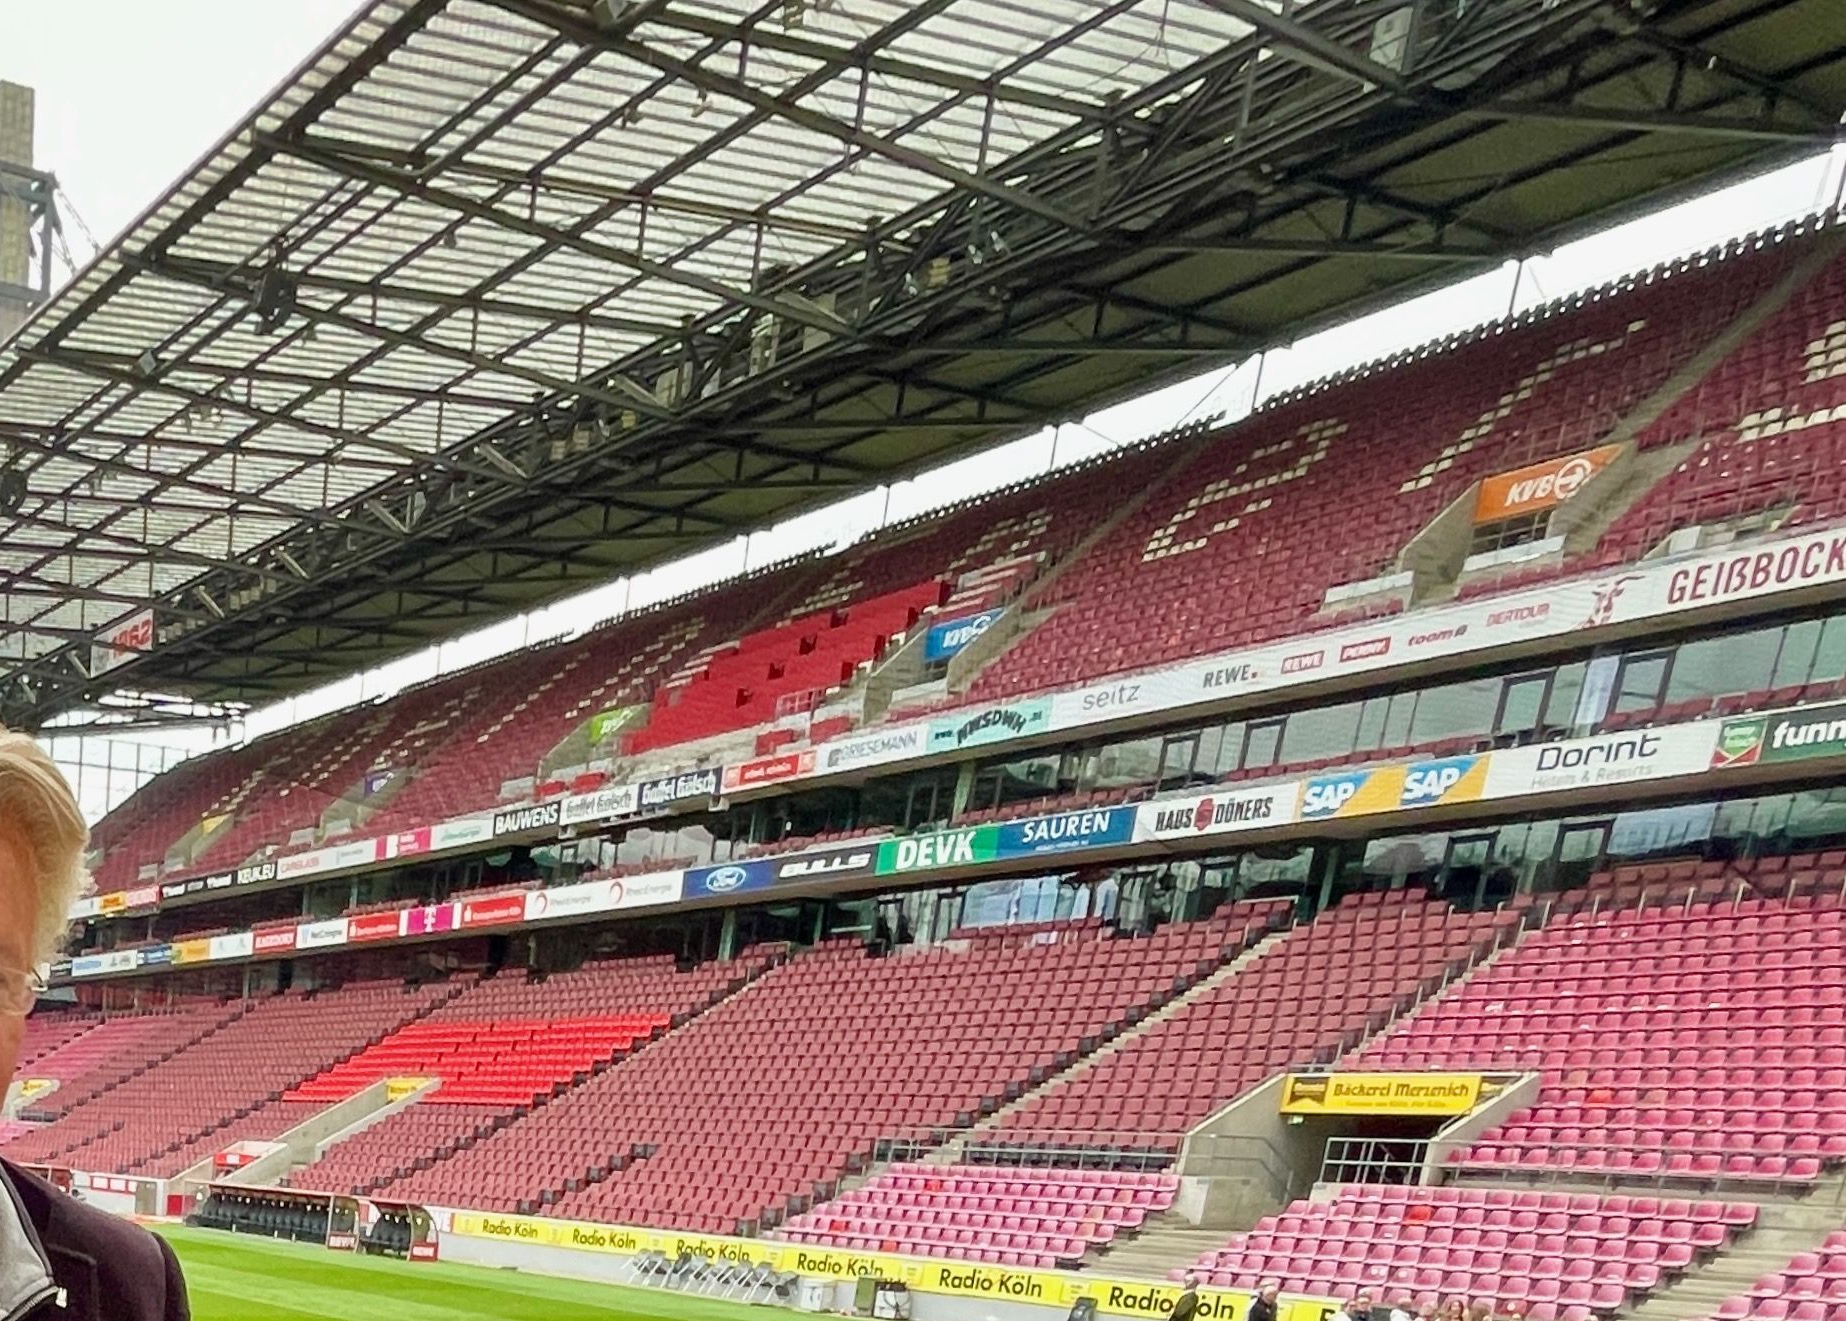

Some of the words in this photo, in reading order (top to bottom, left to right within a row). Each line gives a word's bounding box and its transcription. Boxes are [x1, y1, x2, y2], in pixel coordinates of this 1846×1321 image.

[1408, 630, 1453, 646] toom
[1082, 685, 1140, 710] seitz
[1536, 734, 1661, 770] Dorint
[1304, 782, 1355, 813] SAP
[1405, 768, 1460, 799] SAP
[495, 804, 558, 834] BAUWENS
[1215, 797, 1273, 822] DÖNERS
[1022, 812, 1111, 843] SAUREN
[895, 831, 976, 870] DEVK
[482, 1219, 511, 1236] Radio
[513, 1222, 538, 1239] Köln
[572, 1228, 606, 1247] Radio
[609, 1231, 637, 1250] Köln
[676, 1239, 715, 1260] Radio
[719, 1243, 750, 1262] Köln
[797, 1253, 842, 1275] Radio
[846, 1258, 884, 1277] Köln
[939, 1268, 993, 1291] Radio
[998, 1274, 1042, 1298] Köln
[1108, 1287, 1173, 1315] Radio
[1196, 1294, 1234, 1320] öln
